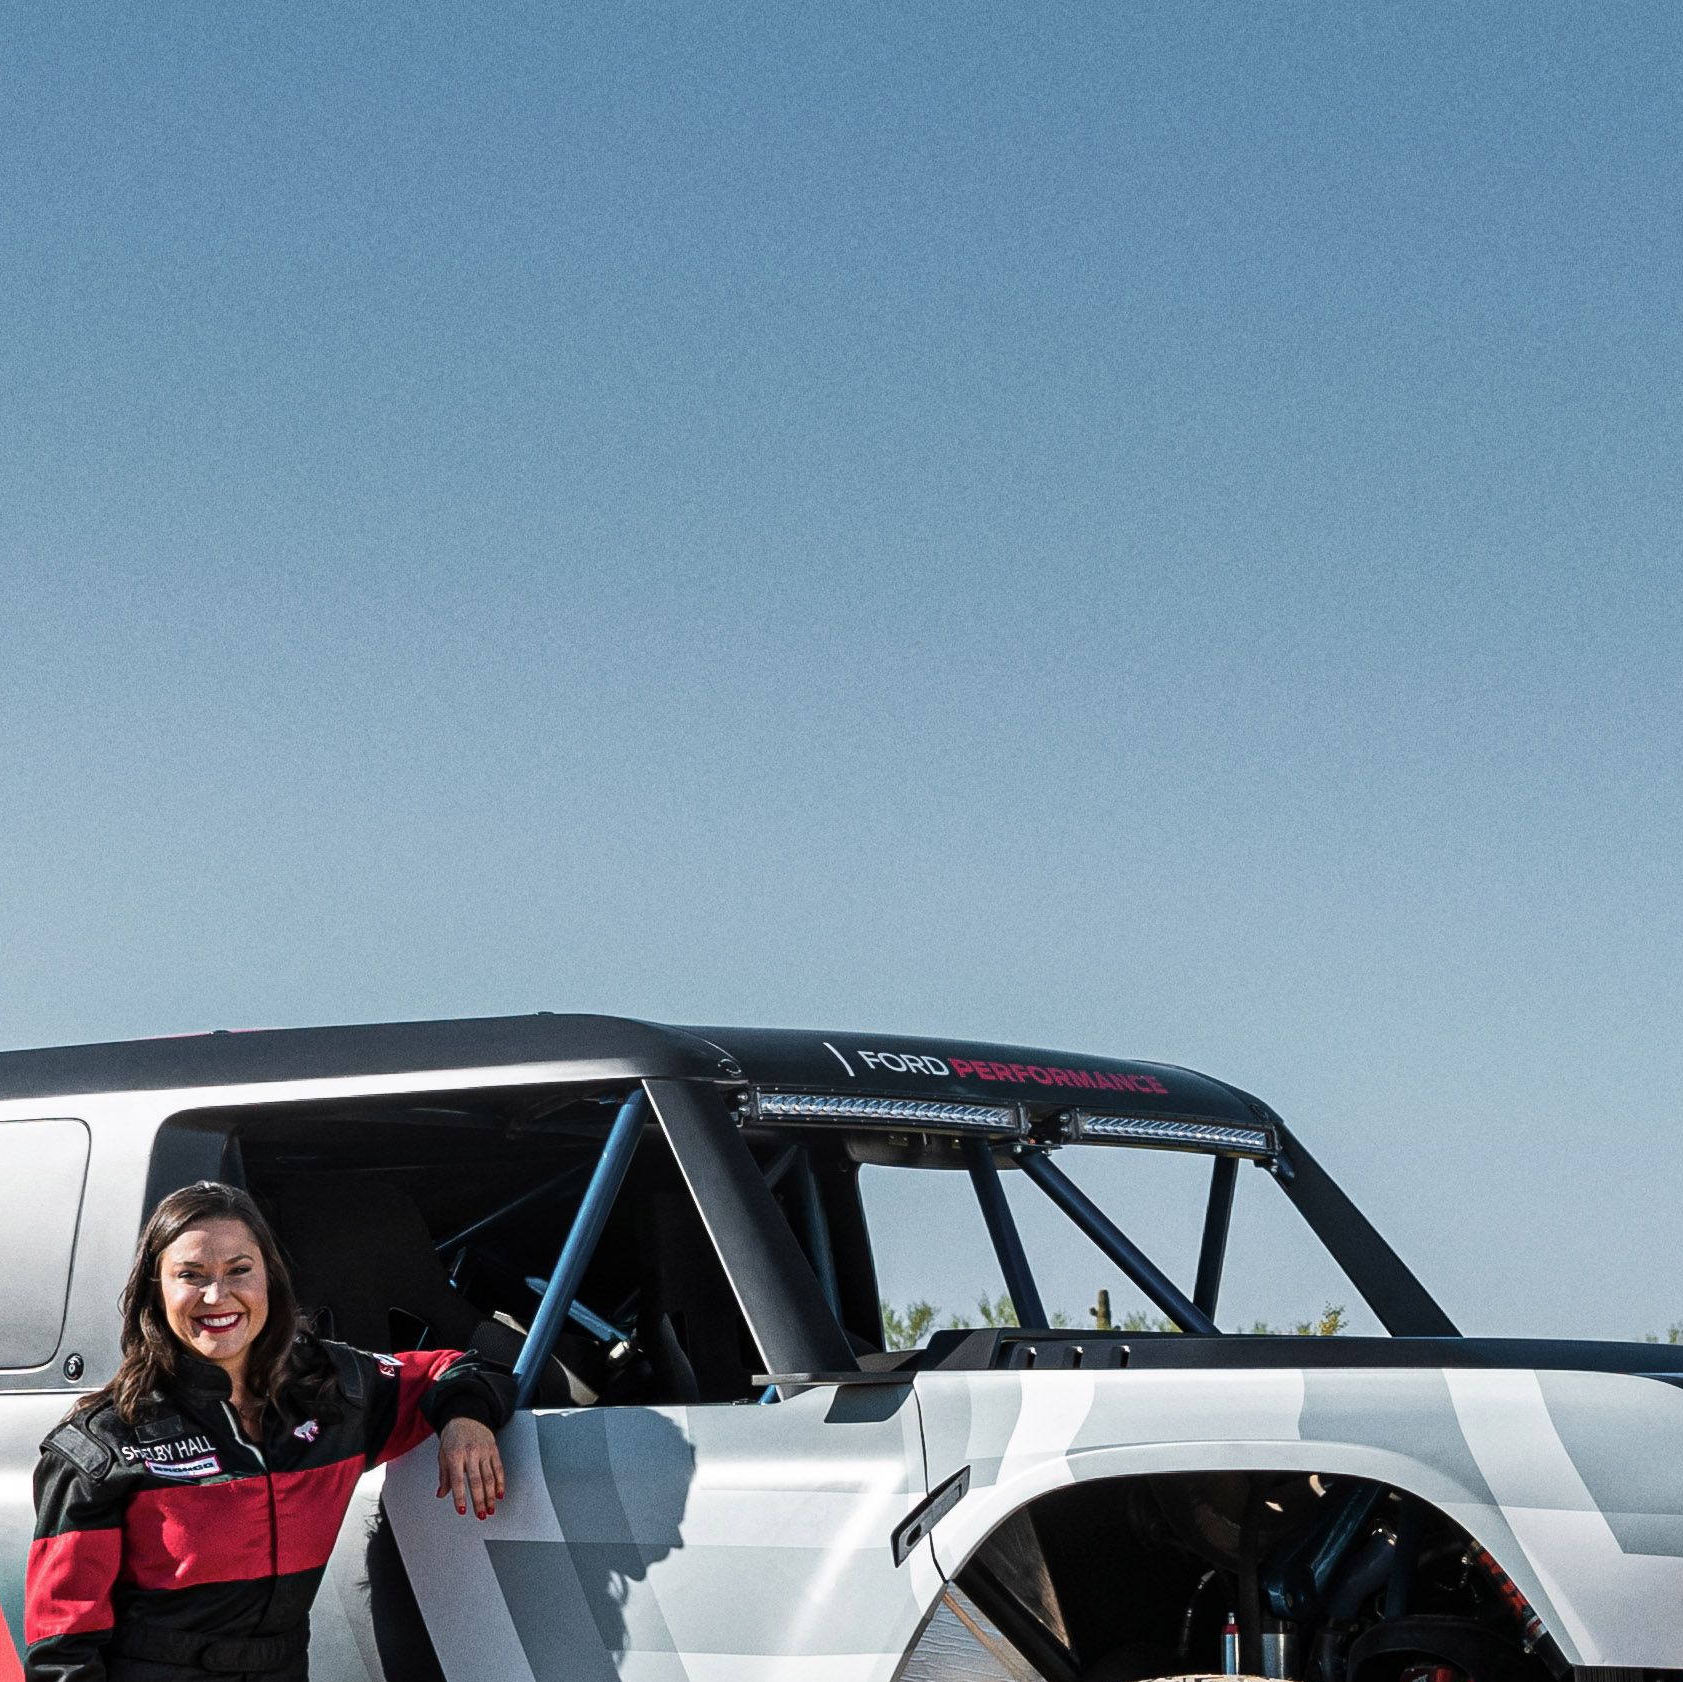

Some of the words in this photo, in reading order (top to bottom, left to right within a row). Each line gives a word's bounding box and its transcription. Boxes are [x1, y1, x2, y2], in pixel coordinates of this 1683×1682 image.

[858, 1050, 949, 1076] FORD
[948, 1057, 1169, 1095] PERFORMANCE
[121, 1443, 175, 1461] SHELBY
[175, 1435, 216, 1459] HALL
